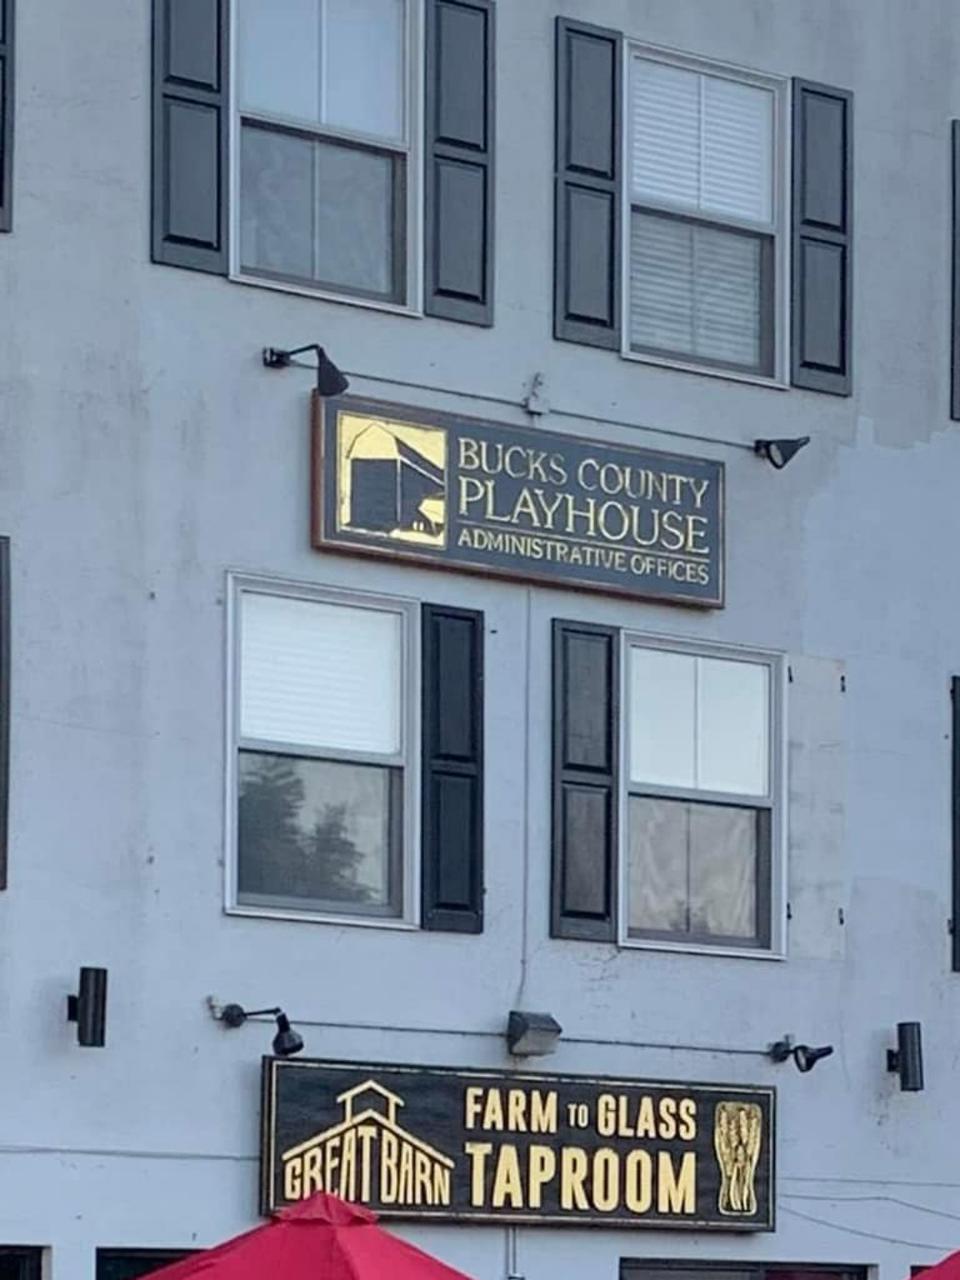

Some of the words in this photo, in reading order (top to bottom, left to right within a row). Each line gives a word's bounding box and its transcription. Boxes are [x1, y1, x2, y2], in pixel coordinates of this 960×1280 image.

[458, 437, 568, 485] BUCKS
[577, 458, 709, 508] COUNTY
[458, 475, 710, 555] PLAYHOUSE
[458, 527, 627, 572] ADMINISTRATIVE
[630, 552, 710, 585] OFFICES
[465, 1086, 557, 1134] FARM
[567, 1103, 589, 1128] TO
[597, 1095, 697, 1141] GLASS
[284, 1125, 378, 1202] GREAT
[380, 1128, 451, 1205] BARN
[465, 1142, 696, 1215] TAPROOM
